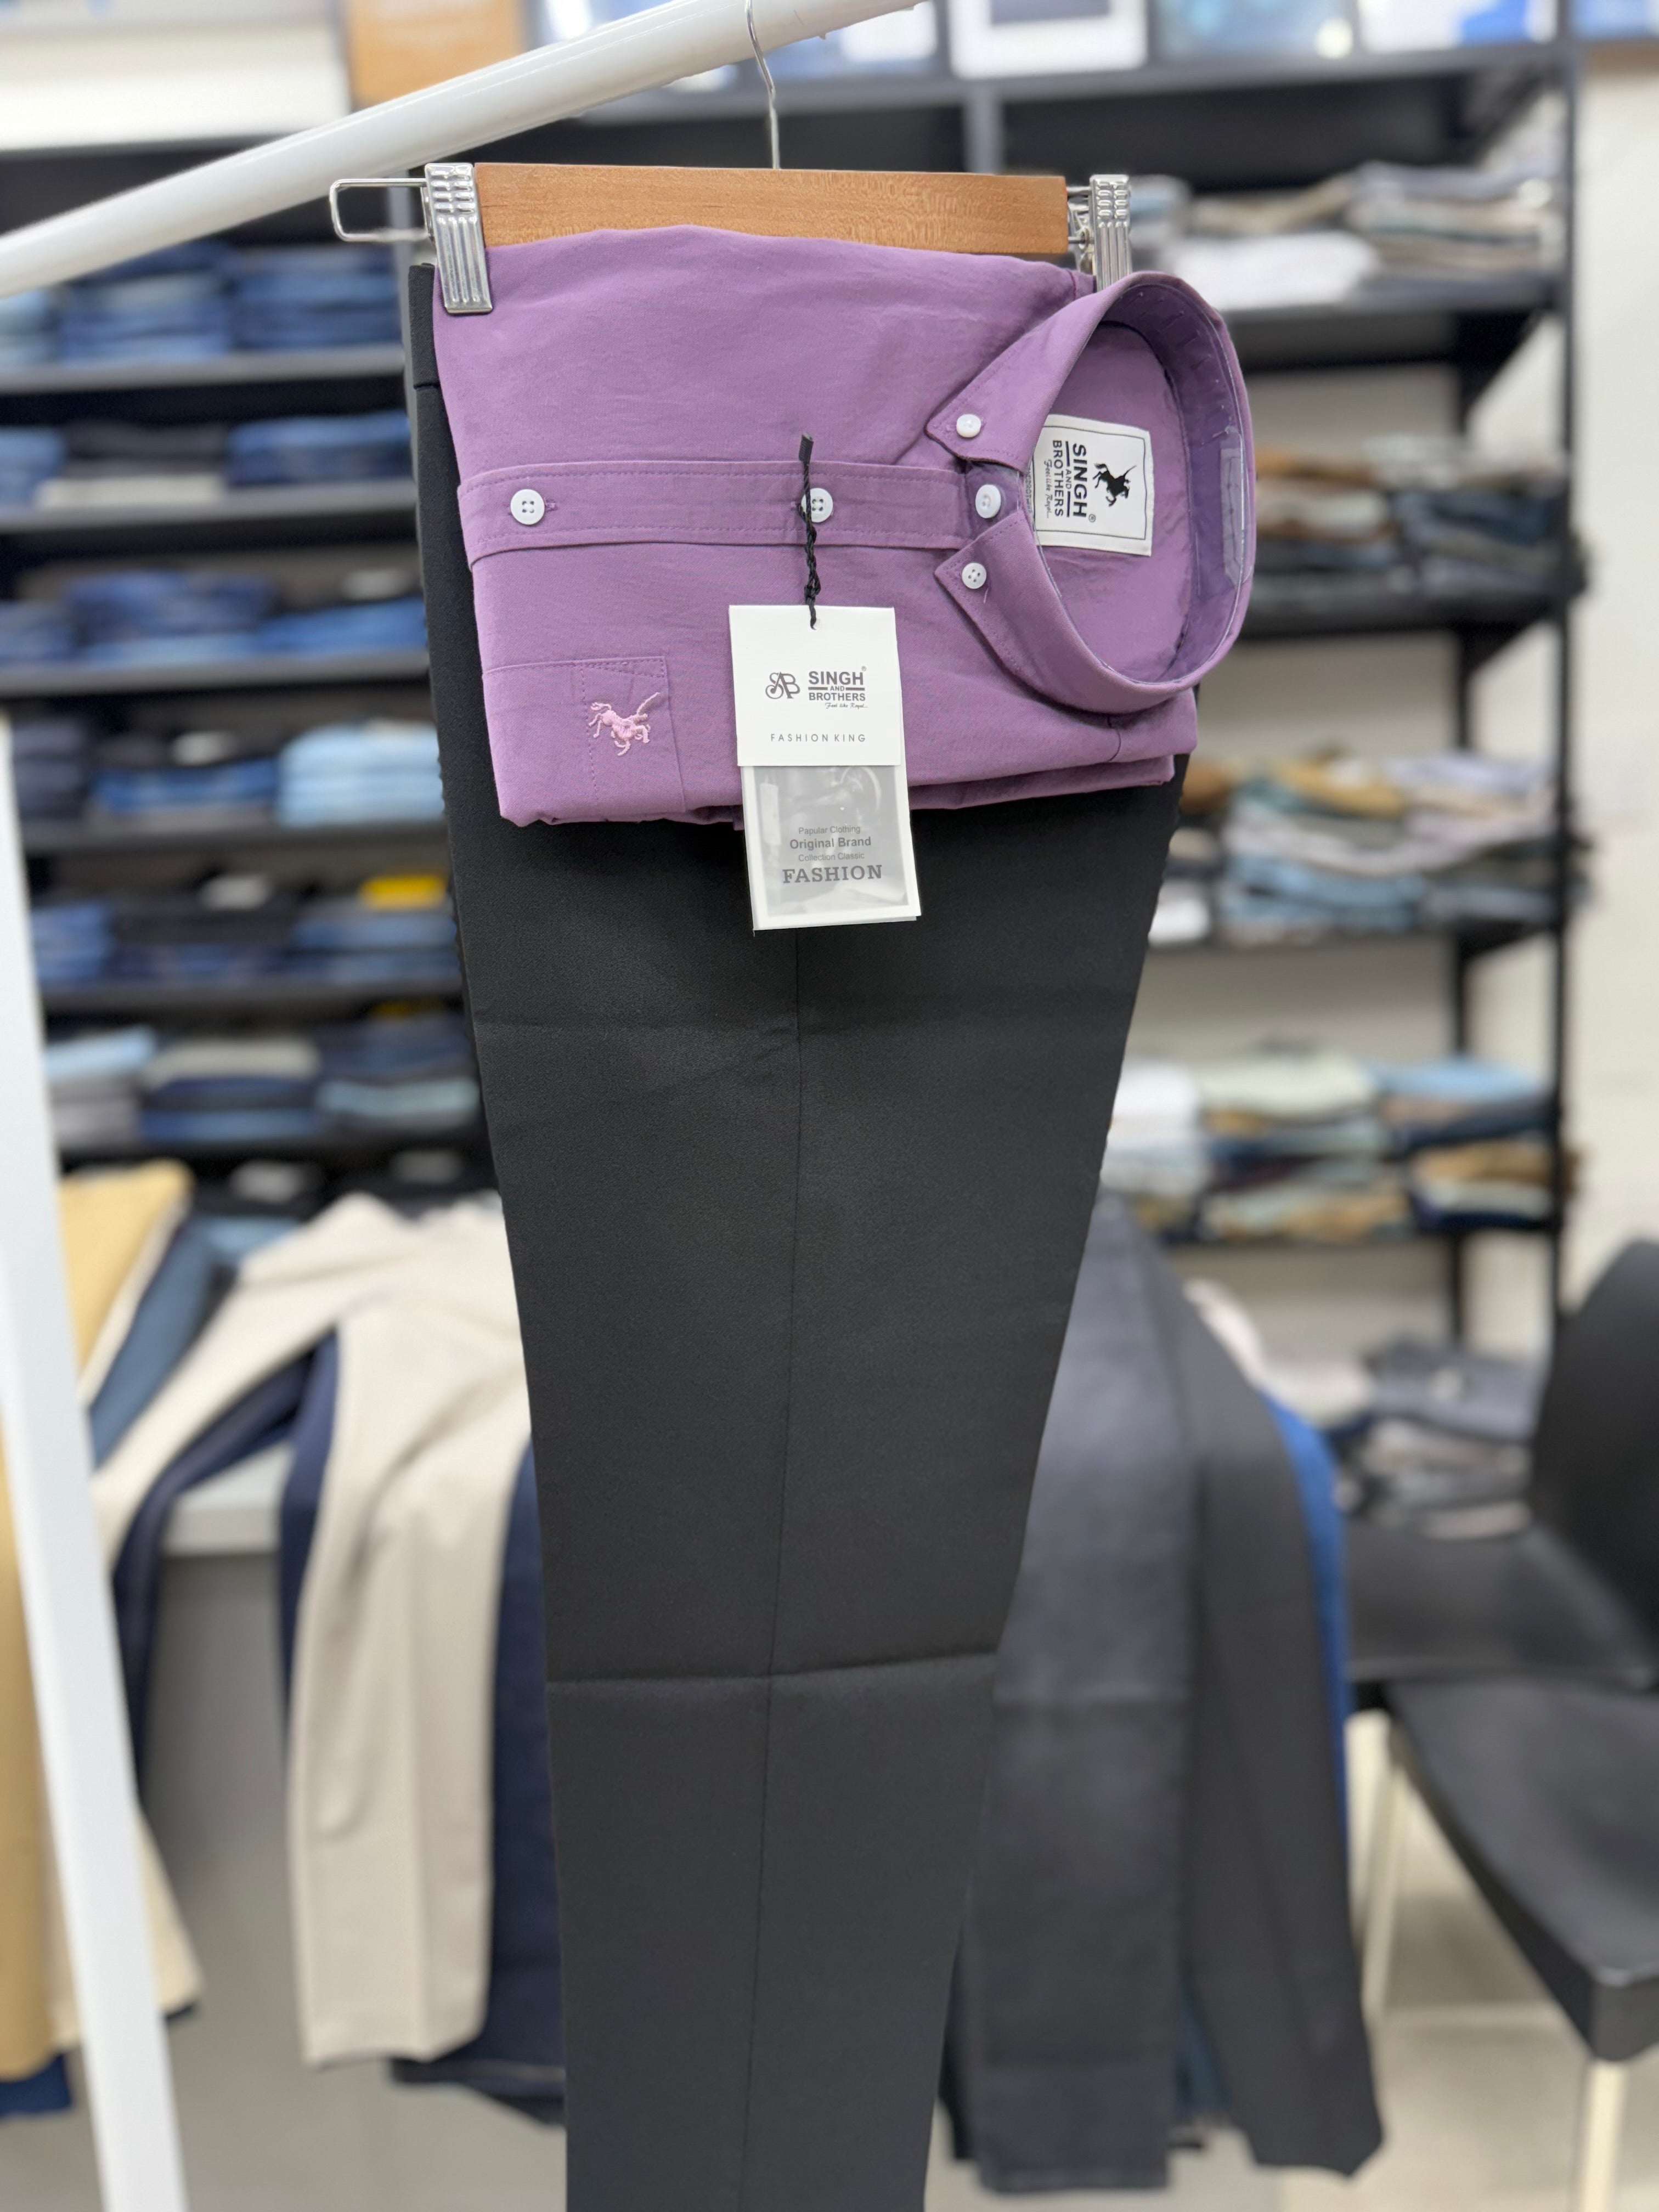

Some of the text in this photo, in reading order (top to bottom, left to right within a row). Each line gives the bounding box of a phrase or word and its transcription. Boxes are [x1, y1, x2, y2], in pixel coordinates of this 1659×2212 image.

[1053, 440, 1063, 517] BROTHERS
[1073, 443, 1087, 517] SINGH
[808, 671, 864, 685] SINGH
[809, 692, 866, 701] BROTHERS
[771, 733, 828, 742] FASHION
[798, 826, 860, 836] Papular Clothing
[790, 836, 871, 851] Original Brand
[838, 852, 865, 860] Classic
[782, 865, 882, 883] FASHION
